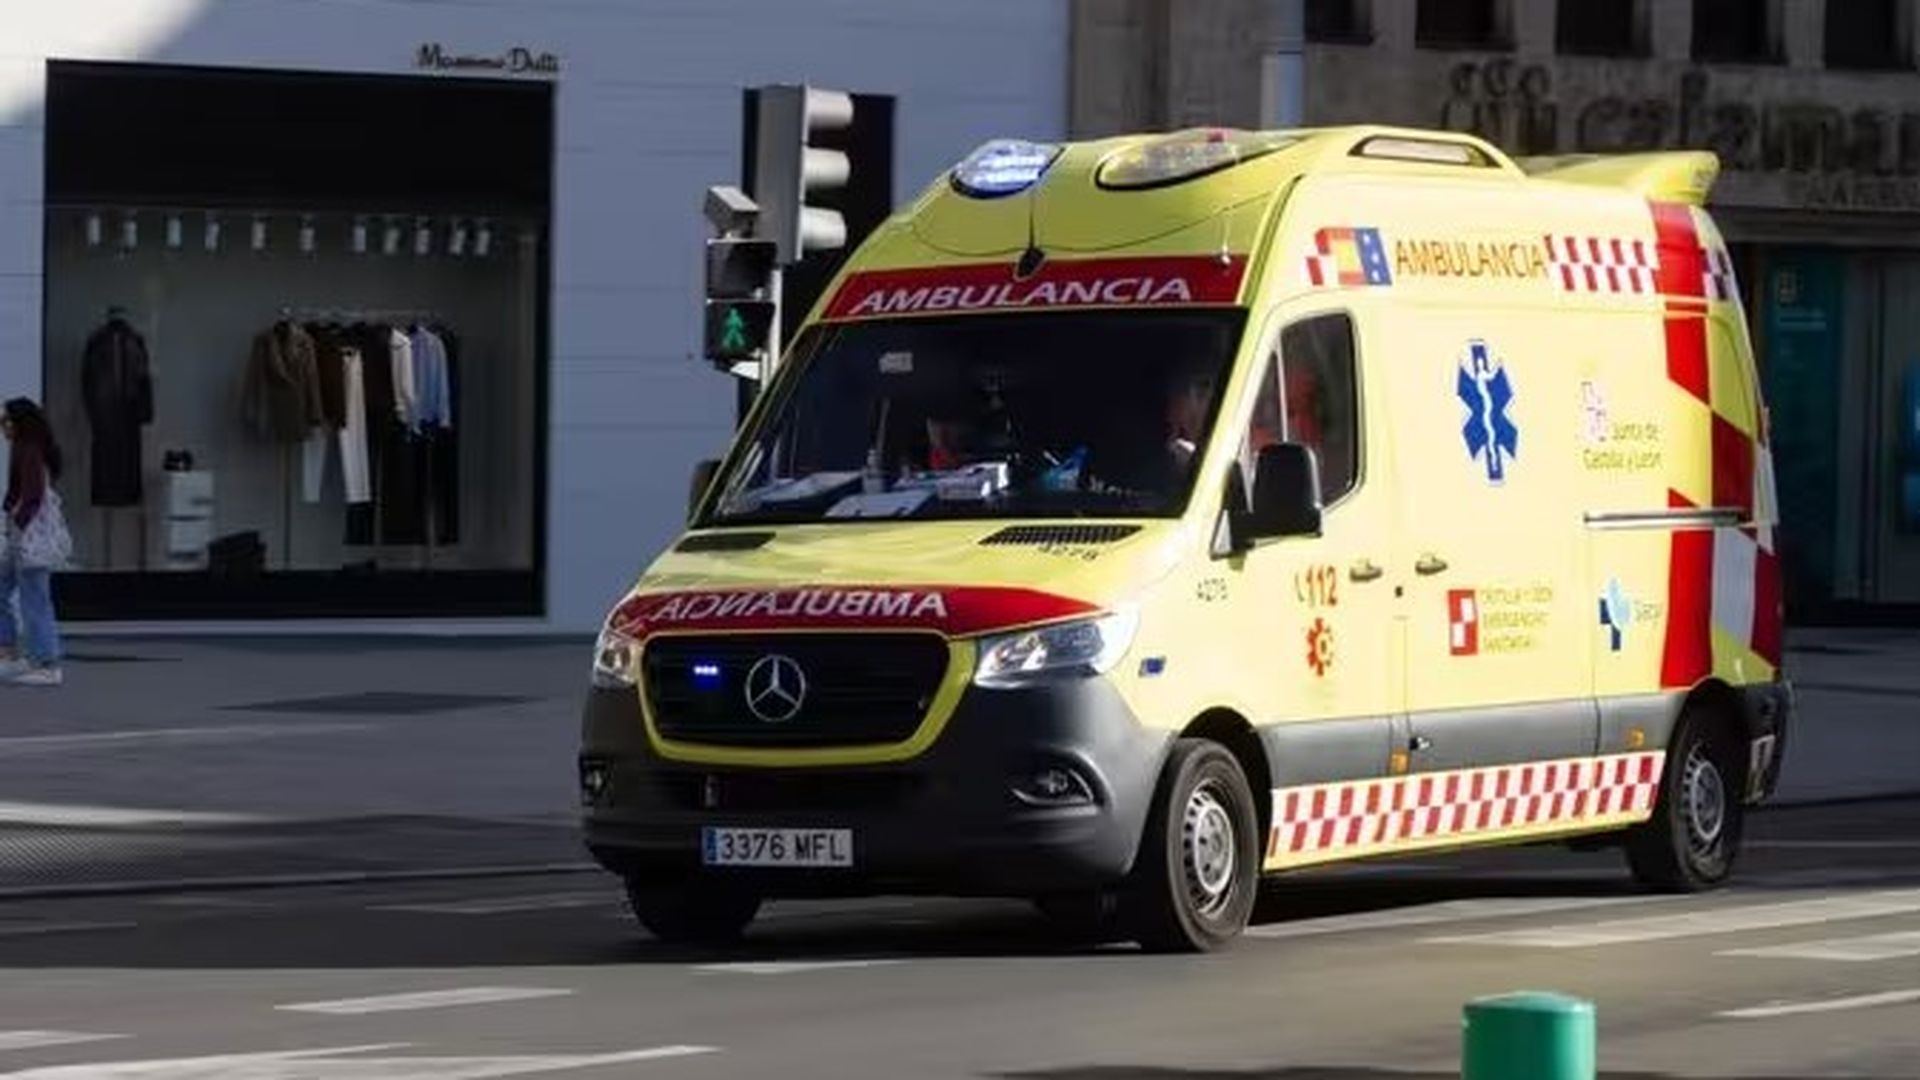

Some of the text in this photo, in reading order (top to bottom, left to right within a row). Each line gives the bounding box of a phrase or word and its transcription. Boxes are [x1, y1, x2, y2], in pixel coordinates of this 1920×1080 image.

[1395, 238, 1549, 280] AMBULANCIA
[848, 277, 1192, 316] AMBULANCIA
[1306, 564, 1338, 608] 112
[721, 832, 846, 861] 3376 MFL
